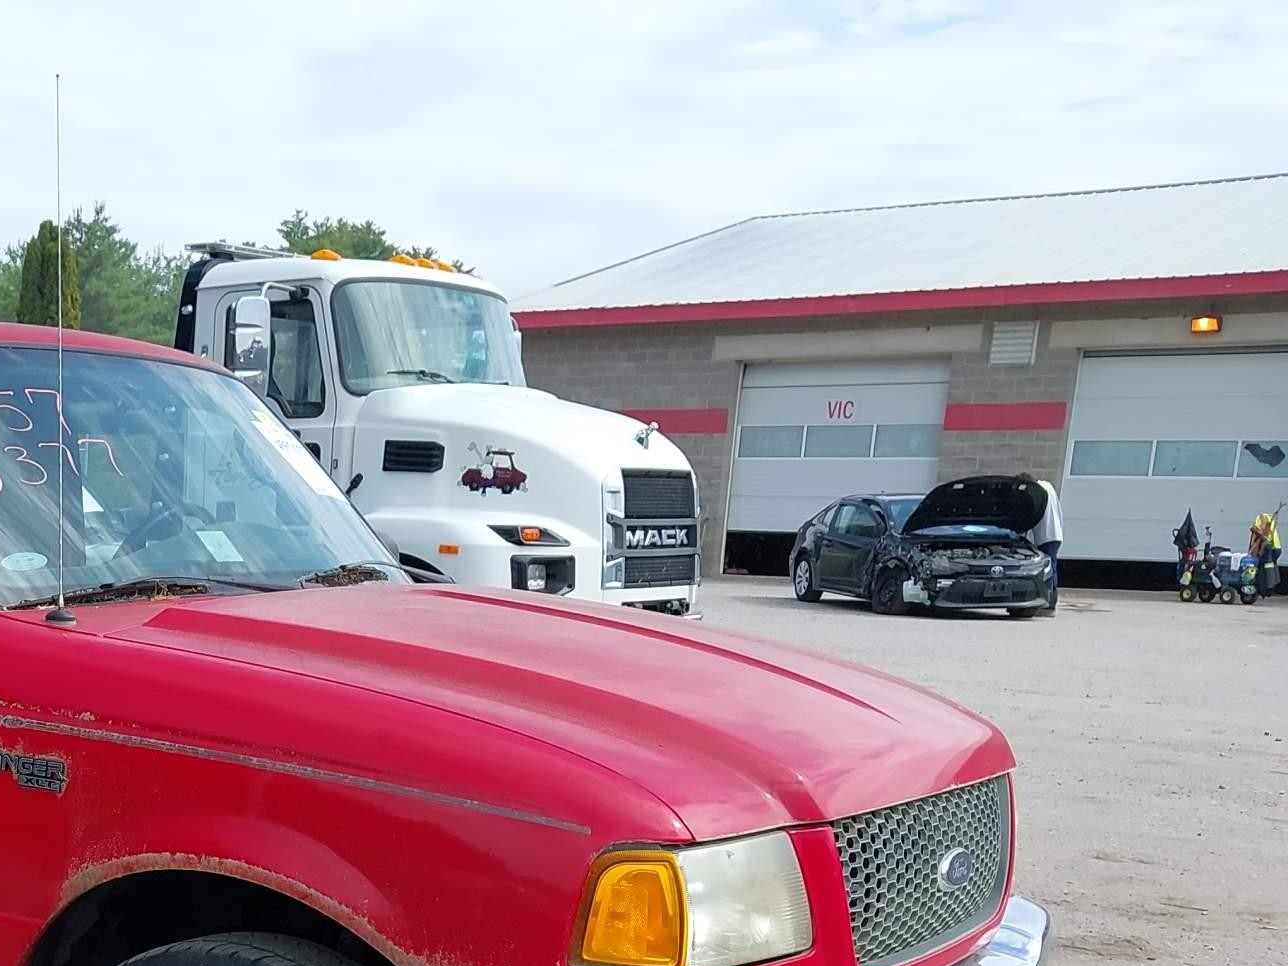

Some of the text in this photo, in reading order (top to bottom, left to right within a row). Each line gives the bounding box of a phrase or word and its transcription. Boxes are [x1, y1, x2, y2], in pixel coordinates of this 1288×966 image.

[827, 400, 855, 420] VIC
[625, 528, 689, 547] MACK
[21, 775, 61, 791] XLT
